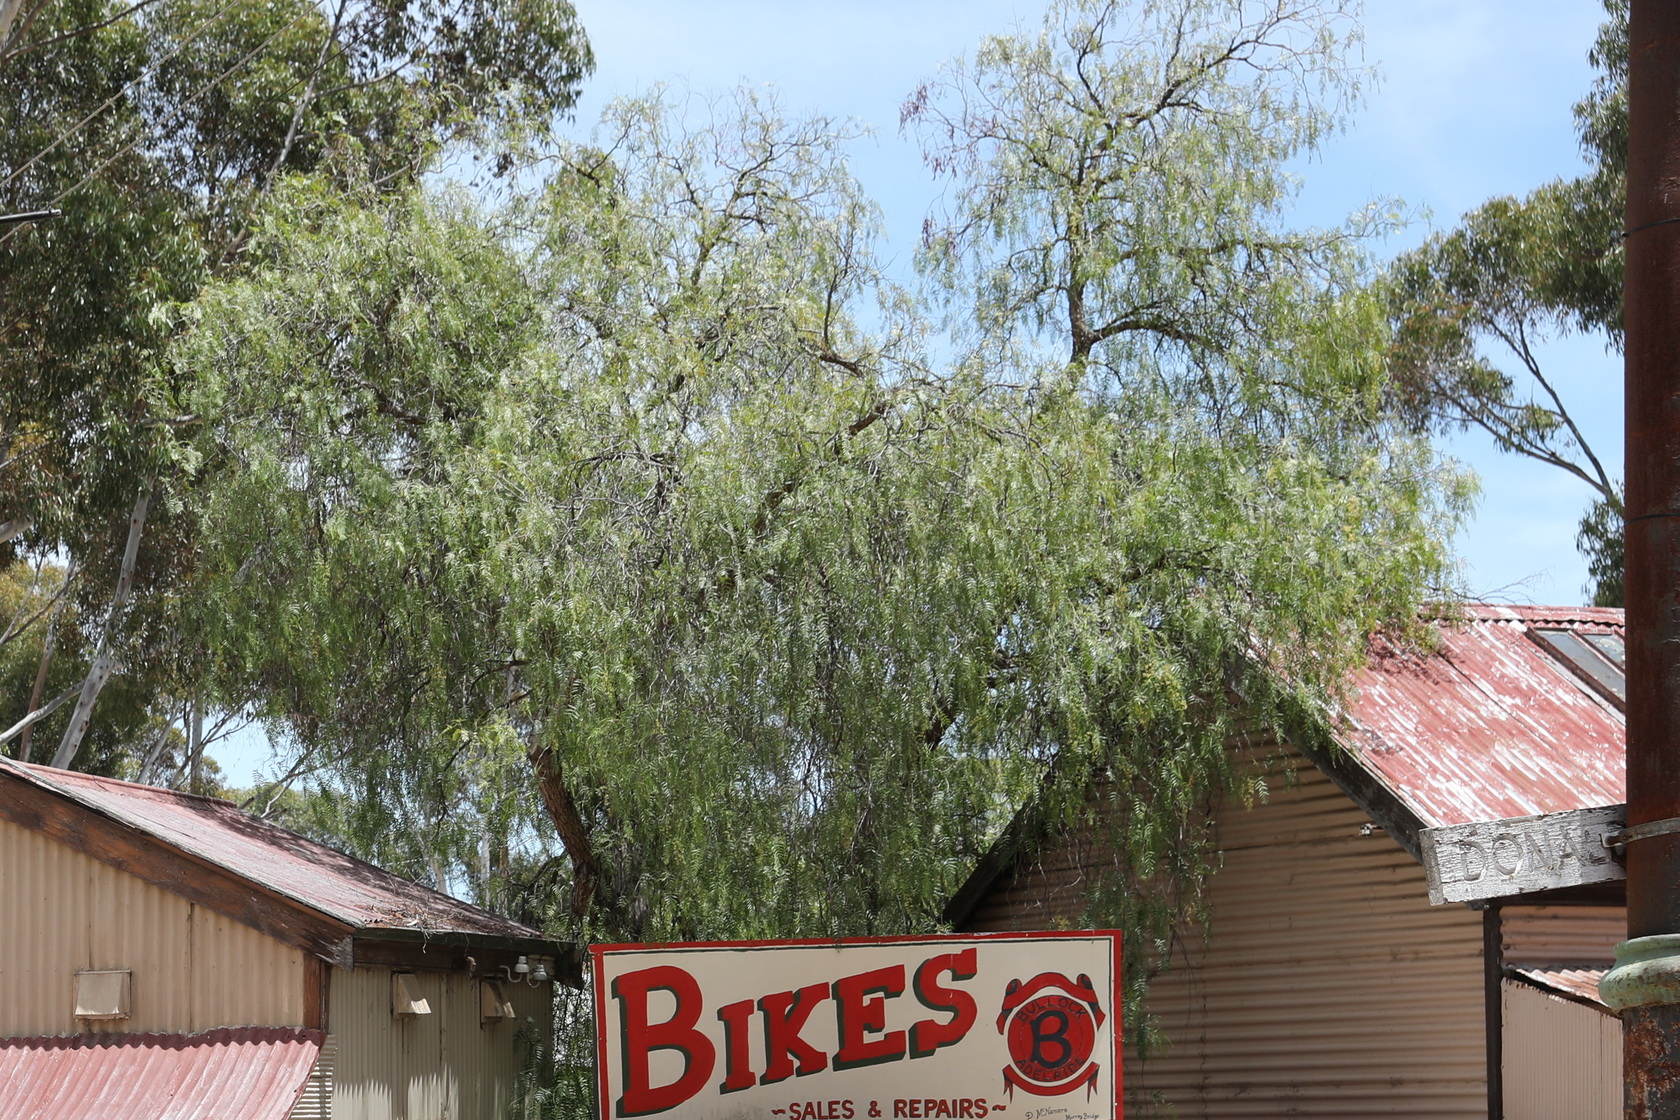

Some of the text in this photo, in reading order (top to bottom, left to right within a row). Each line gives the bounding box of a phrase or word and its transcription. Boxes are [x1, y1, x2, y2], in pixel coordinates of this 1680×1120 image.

[1016, 997, 1087, 1022] BULLOCK
[611, 947, 977, 1118] BIKES
[1030, 1010, 1072, 1069] B
[1016, 1059, 1083, 1080] ADELAIDE
[868, 1102, 882, 1119] &
[893, 1098, 988, 1119] REPAIRS
